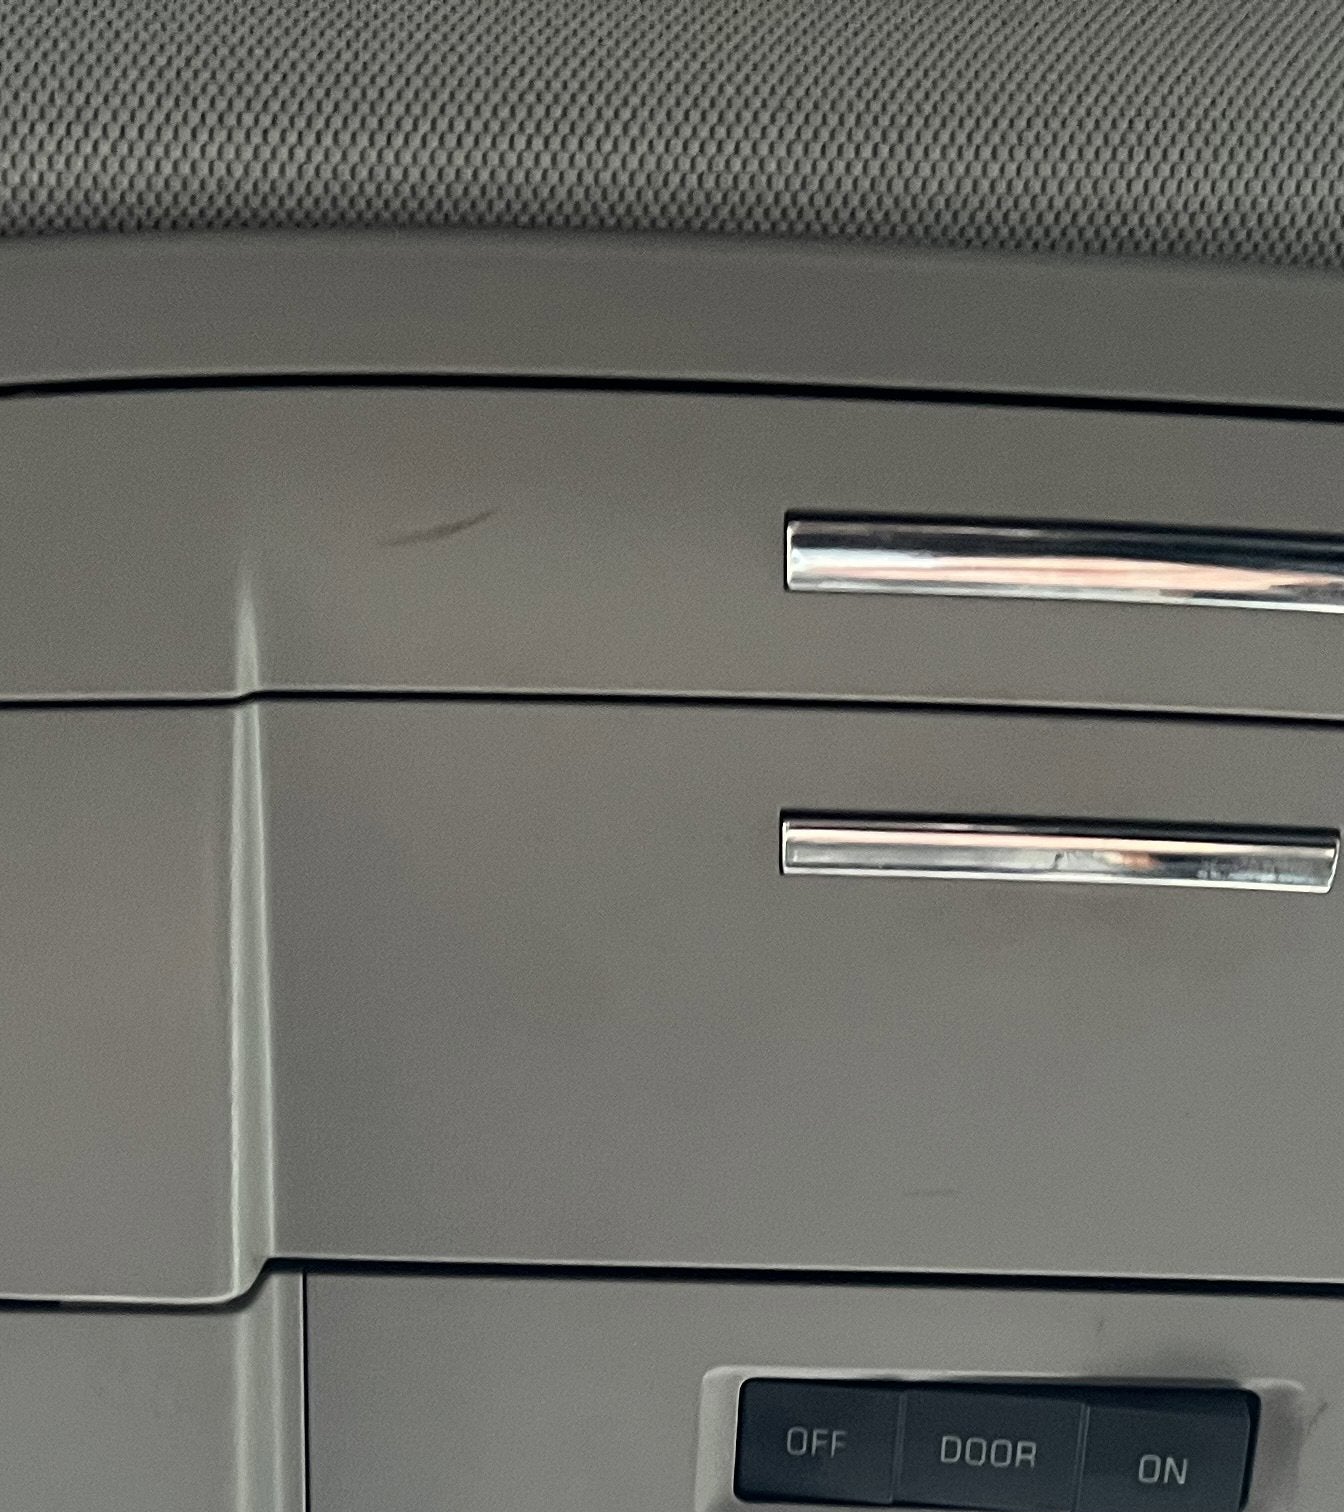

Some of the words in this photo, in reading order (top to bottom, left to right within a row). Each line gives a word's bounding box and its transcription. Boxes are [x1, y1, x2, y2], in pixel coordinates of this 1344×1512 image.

[786, 1426, 847, 1458] OFF
[940, 1435, 1037, 1468] DOOR
[1138, 1454, 1188, 1485] ON
